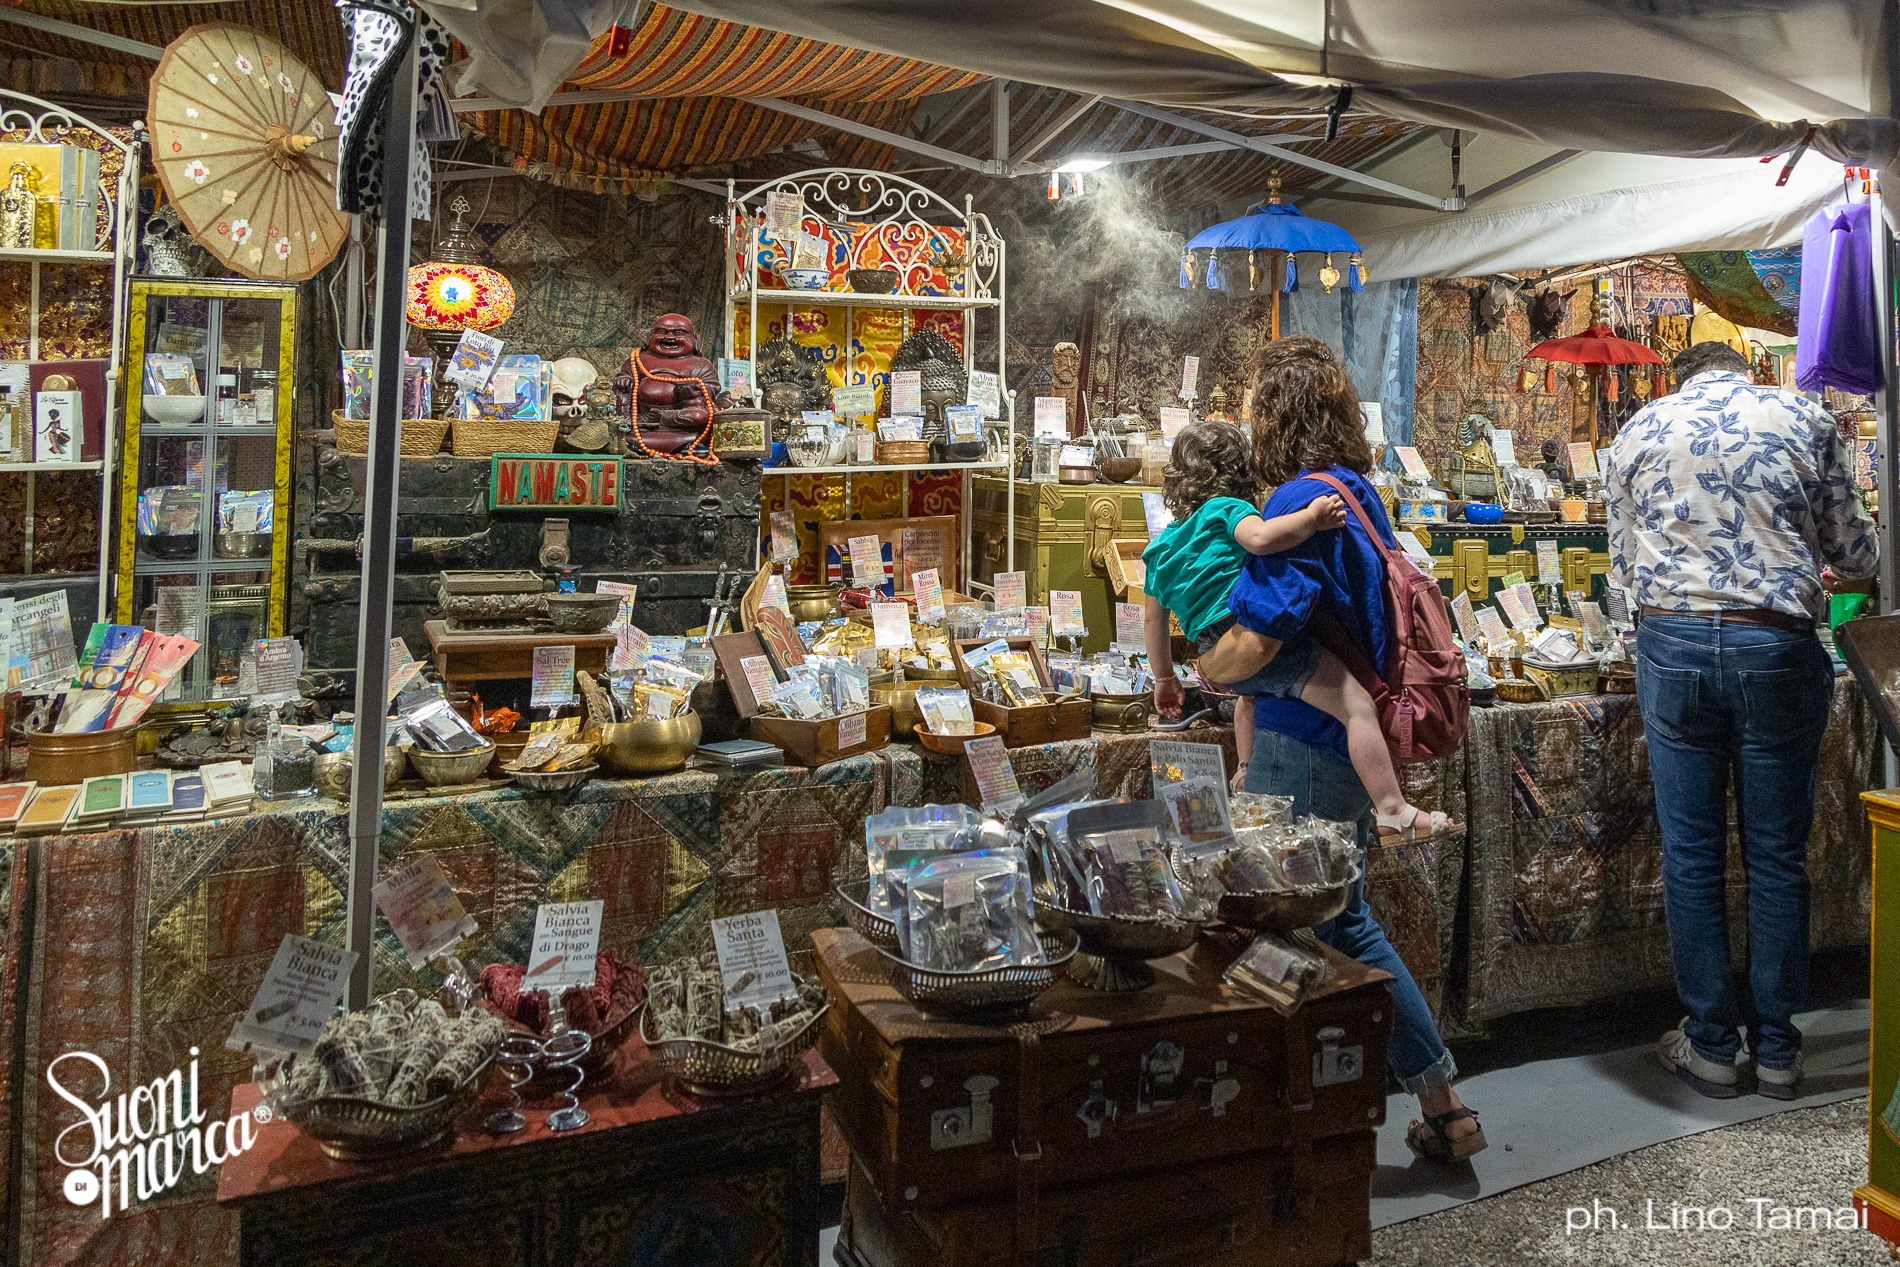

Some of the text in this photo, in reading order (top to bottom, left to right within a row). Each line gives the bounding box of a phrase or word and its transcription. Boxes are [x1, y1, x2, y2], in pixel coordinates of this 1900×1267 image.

[165, 336, 203, 349] Damiana
[465, 335, 482, 347] Loto
[471, 331, 496, 346] Fiori di
[726, 367, 744, 377] Loto
[893, 378, 919, 387] Guayaco
[500, 461, 616, 505] NAMASTE
[853, 537, 875, 545] Sabbia
[917, 571, 934, 580] Mirra
[598, 581, 636, 592] Frankincense
[39, 591, 65, 606] degli
[1056, 591, 1075, 600] Rosa
[1123, 603, 1140, 612] Rosa
[1123, 610, 1140, 619] Nera
[263, 646, 288, 656] Ambra
[537, 656, 571, 665] Sal Tree
[743, 659, 768, 669] Olibano
[840, 717, 865, 731] Olibano
[1153, 743, 1219, 756] Salvia Bianca
[1165, 754, 1187, 764] Palo
[1187, 755, 1217, 765] Santo
[1180, 782, 1197, 793] Set
[549, 903, 588, 917] Salvia
[545, 915, 590, 928] Bianca
[724, 915, 762, 930] Yerba
[551, 927, 593, 939] Sangue
[726, 928, 765, 943] Santa
[539, 940, 590, 953] di Drago
[297, 941, 342, 966] Salvia
[572, 953, 596, 961] 10.00
[287, 954, 338, 981] Bianca
[765, 969, 788, 979] 10.00
